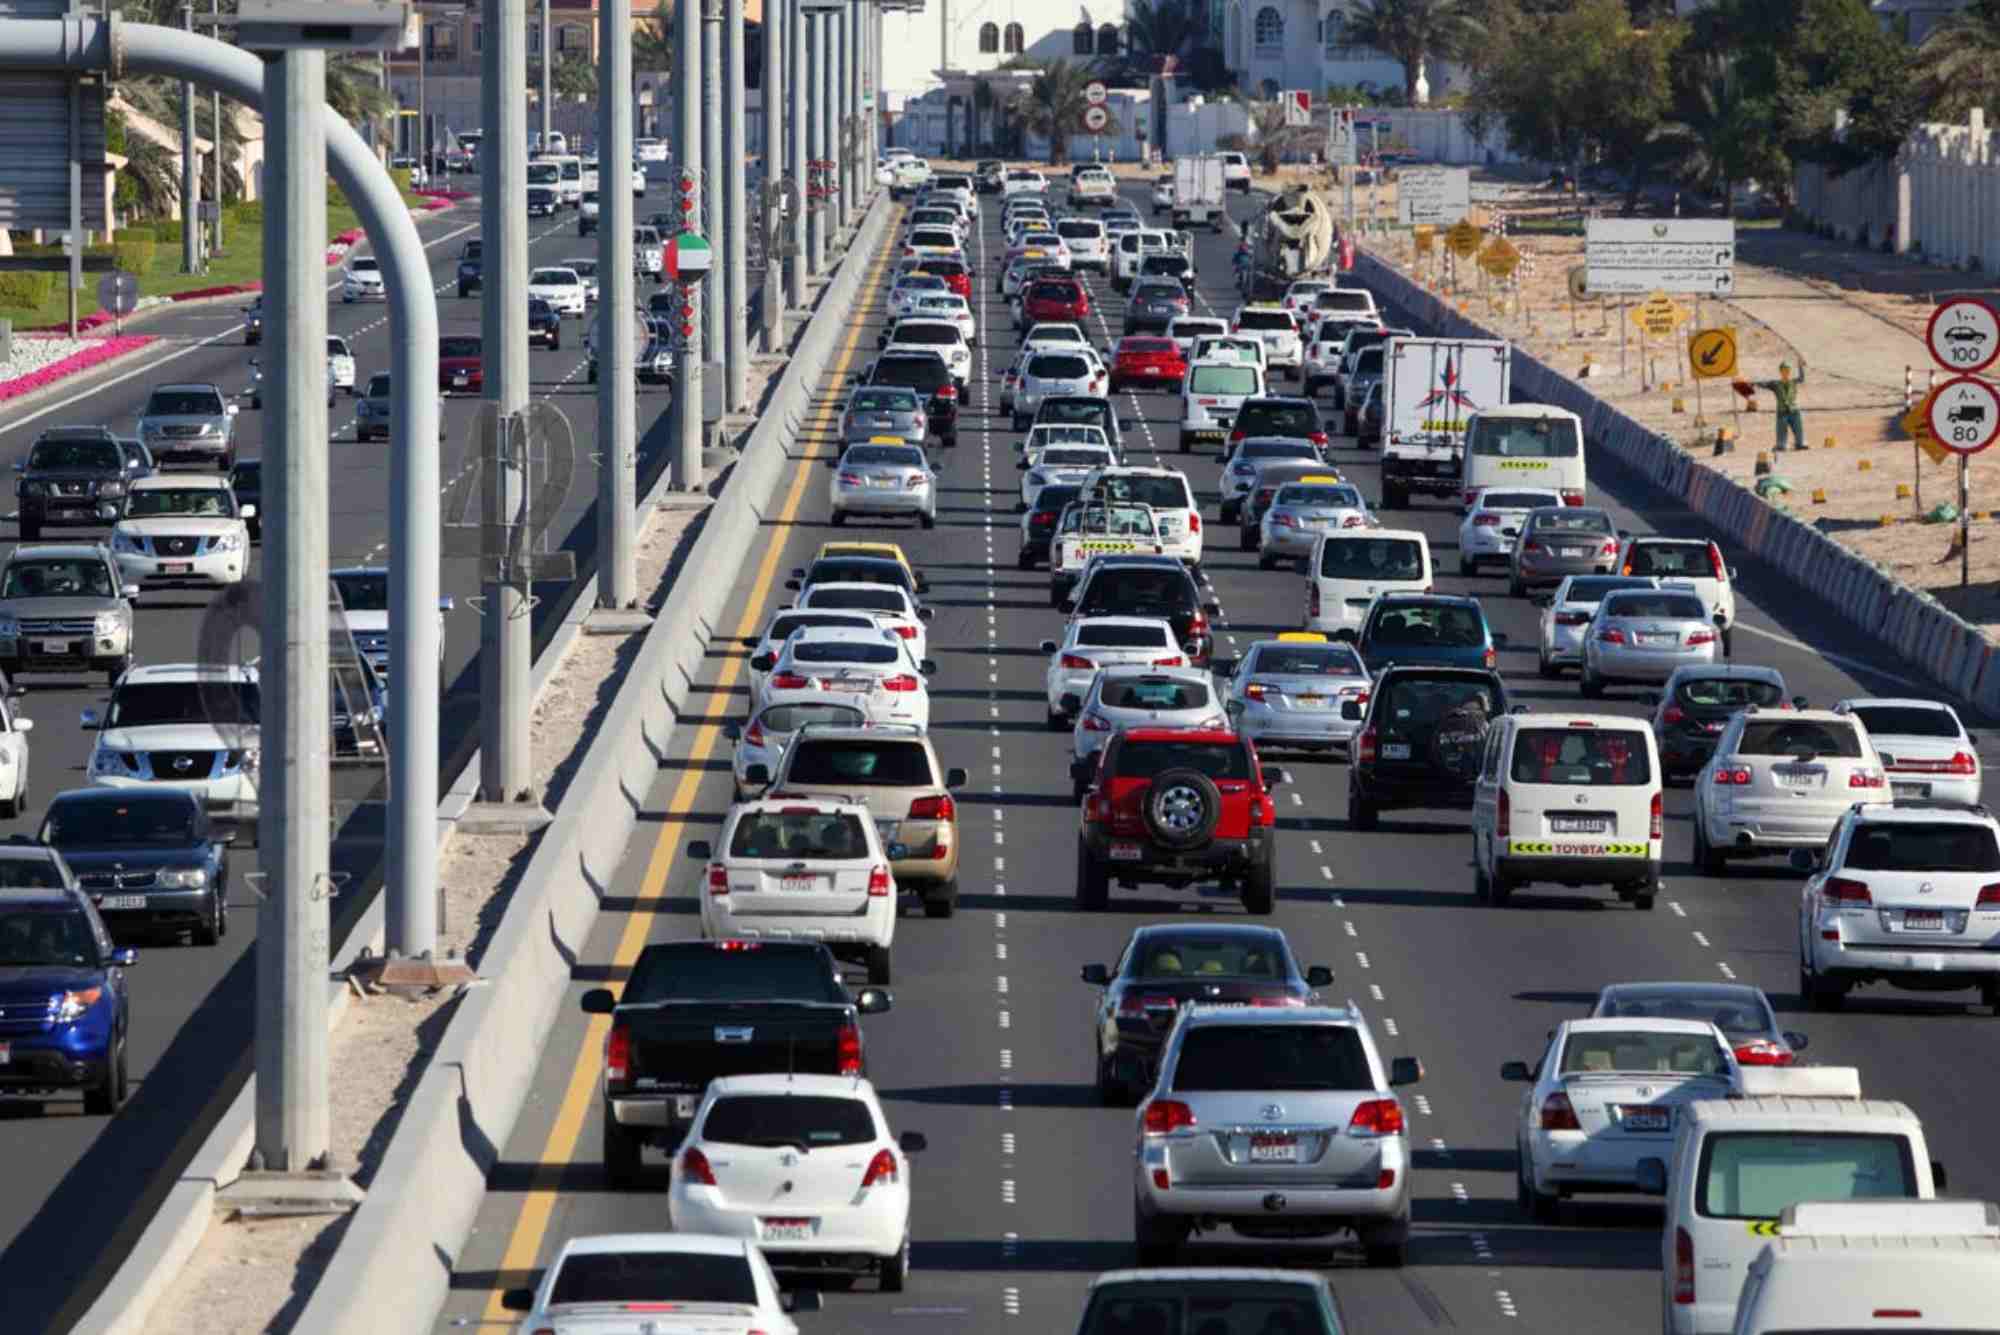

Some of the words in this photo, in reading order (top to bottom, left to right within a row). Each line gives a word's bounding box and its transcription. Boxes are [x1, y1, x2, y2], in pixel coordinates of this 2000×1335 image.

[1955, 309, 1976, 321] ١٠٠
[1951, 347, 1980, 362] 100
[1958, 389, 1976, 399] ٨٠
[1953, 426, 1978, 441] 80
[1555, 844, 1606, 854] TOYOTA
